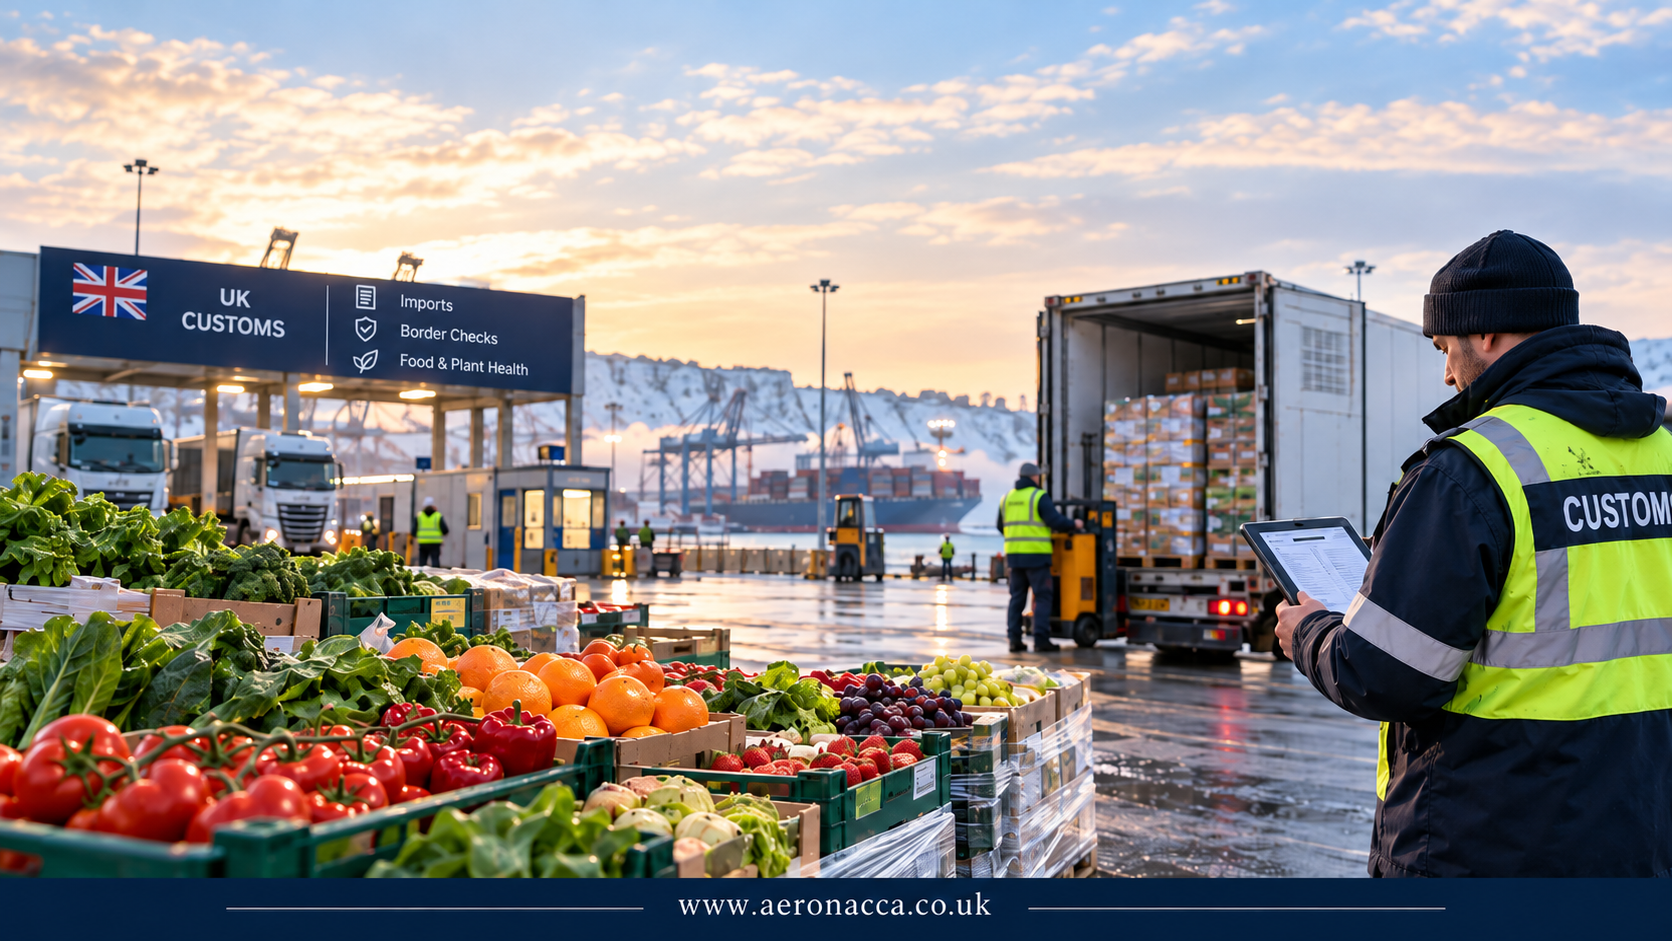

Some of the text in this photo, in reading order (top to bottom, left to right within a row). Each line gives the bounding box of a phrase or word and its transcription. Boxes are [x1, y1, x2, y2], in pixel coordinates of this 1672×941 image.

[220, 288, 251, 308] UK
[400, 294, 454, 312] Imports
[181, 311, 286, 338] CUSTOMS
[400, 324, 498, 345] Border Checks
[400, 353, 529, 376] Food & Plant Health
[1563, 491, 1672, 532] CUSTOM
